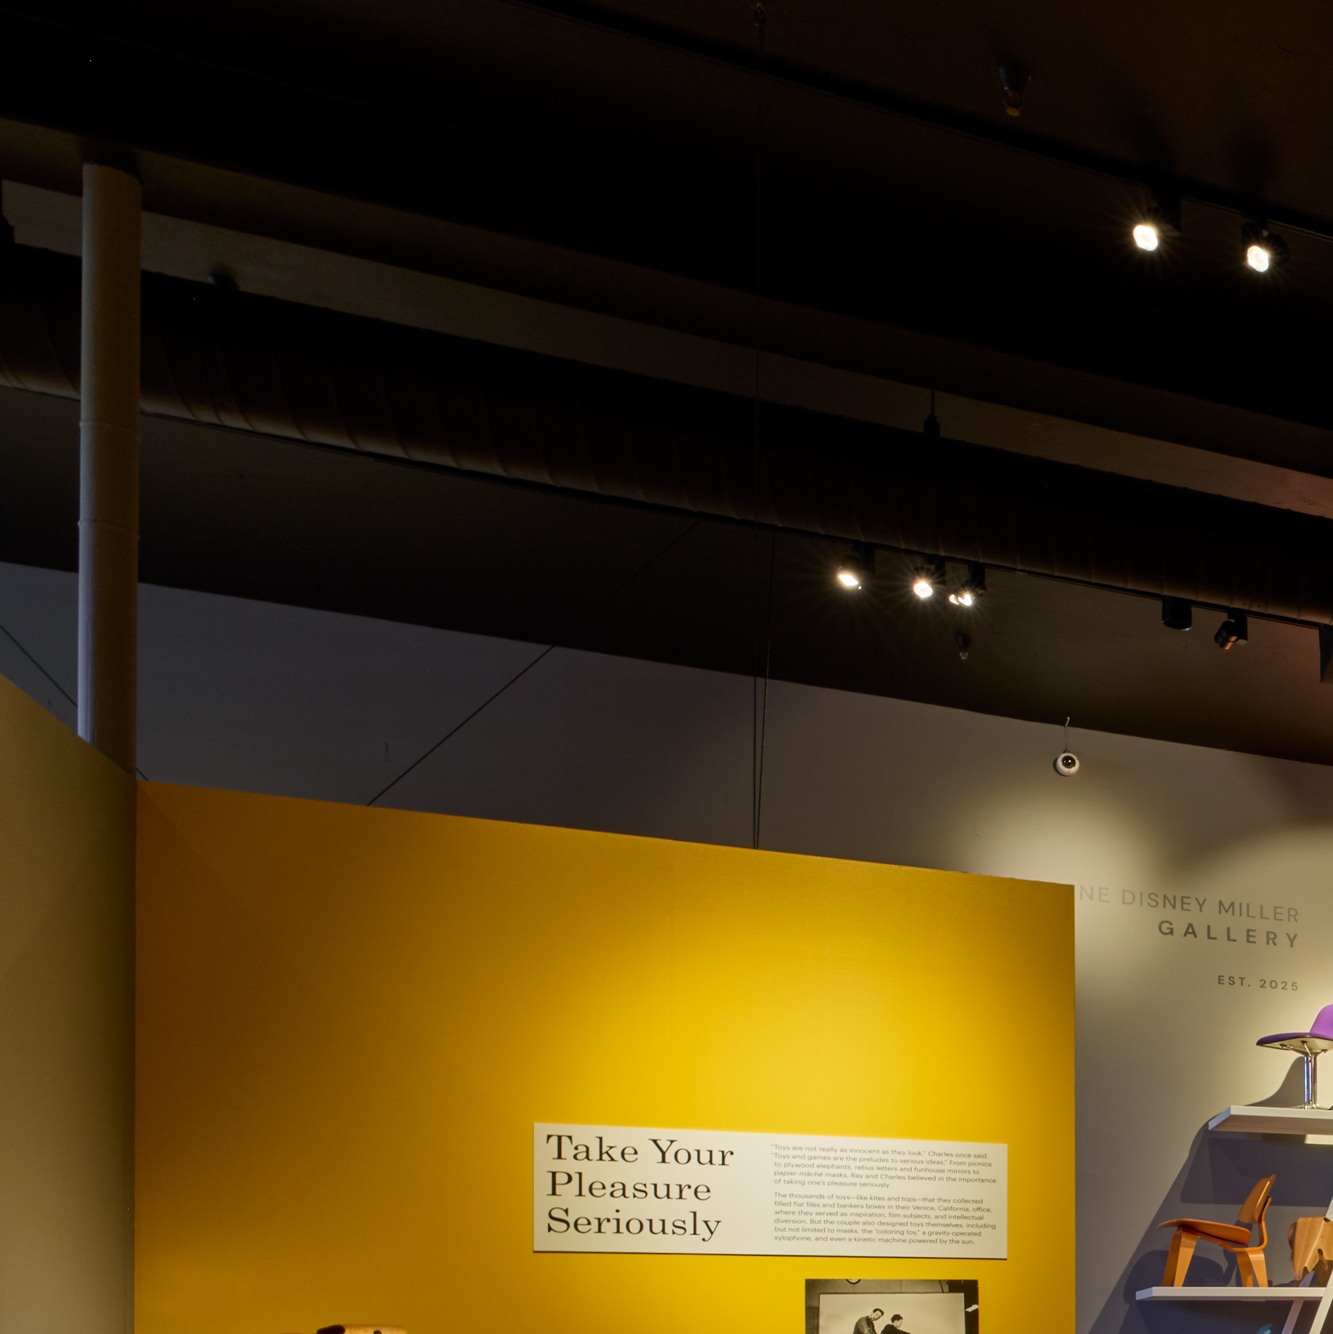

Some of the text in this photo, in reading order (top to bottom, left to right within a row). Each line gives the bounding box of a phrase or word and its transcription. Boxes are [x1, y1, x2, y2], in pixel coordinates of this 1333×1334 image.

[1079, 885, 1298, 923] NE DISNEY MILLER
[1158, 920, 1298, 948] GALLERY
[1218, 975, 1298, 991] EST. 2025
[546, 1134, 734, 1167] Take Your
[546, 1170, 711, 1200] Pleasure
[546, 1207, 721, 1242] Seriously
